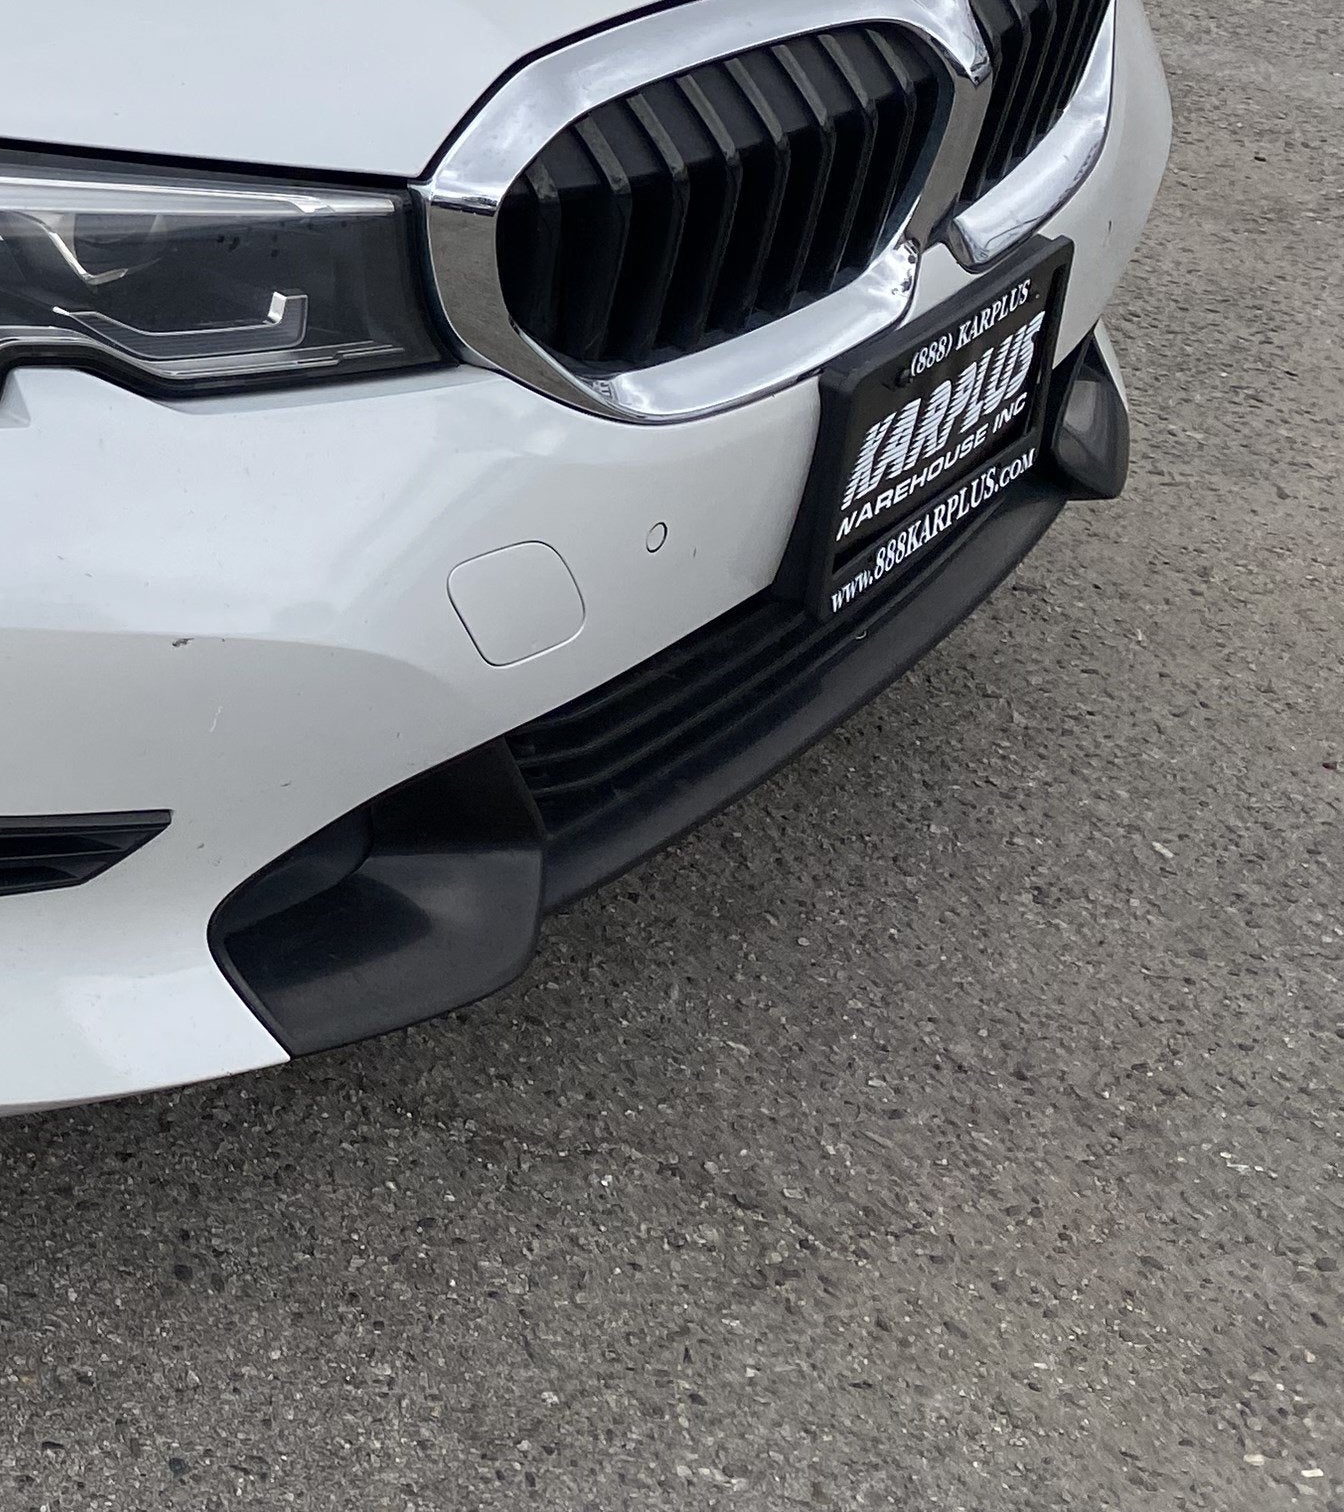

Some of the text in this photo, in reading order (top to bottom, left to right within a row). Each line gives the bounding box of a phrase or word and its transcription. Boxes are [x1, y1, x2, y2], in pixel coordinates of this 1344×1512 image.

[911, 279, 1031, 376] (888) KARPLUS
[841, 311, 1046, 510] KARPLUS
[992, 392, 1028, 434] INC
